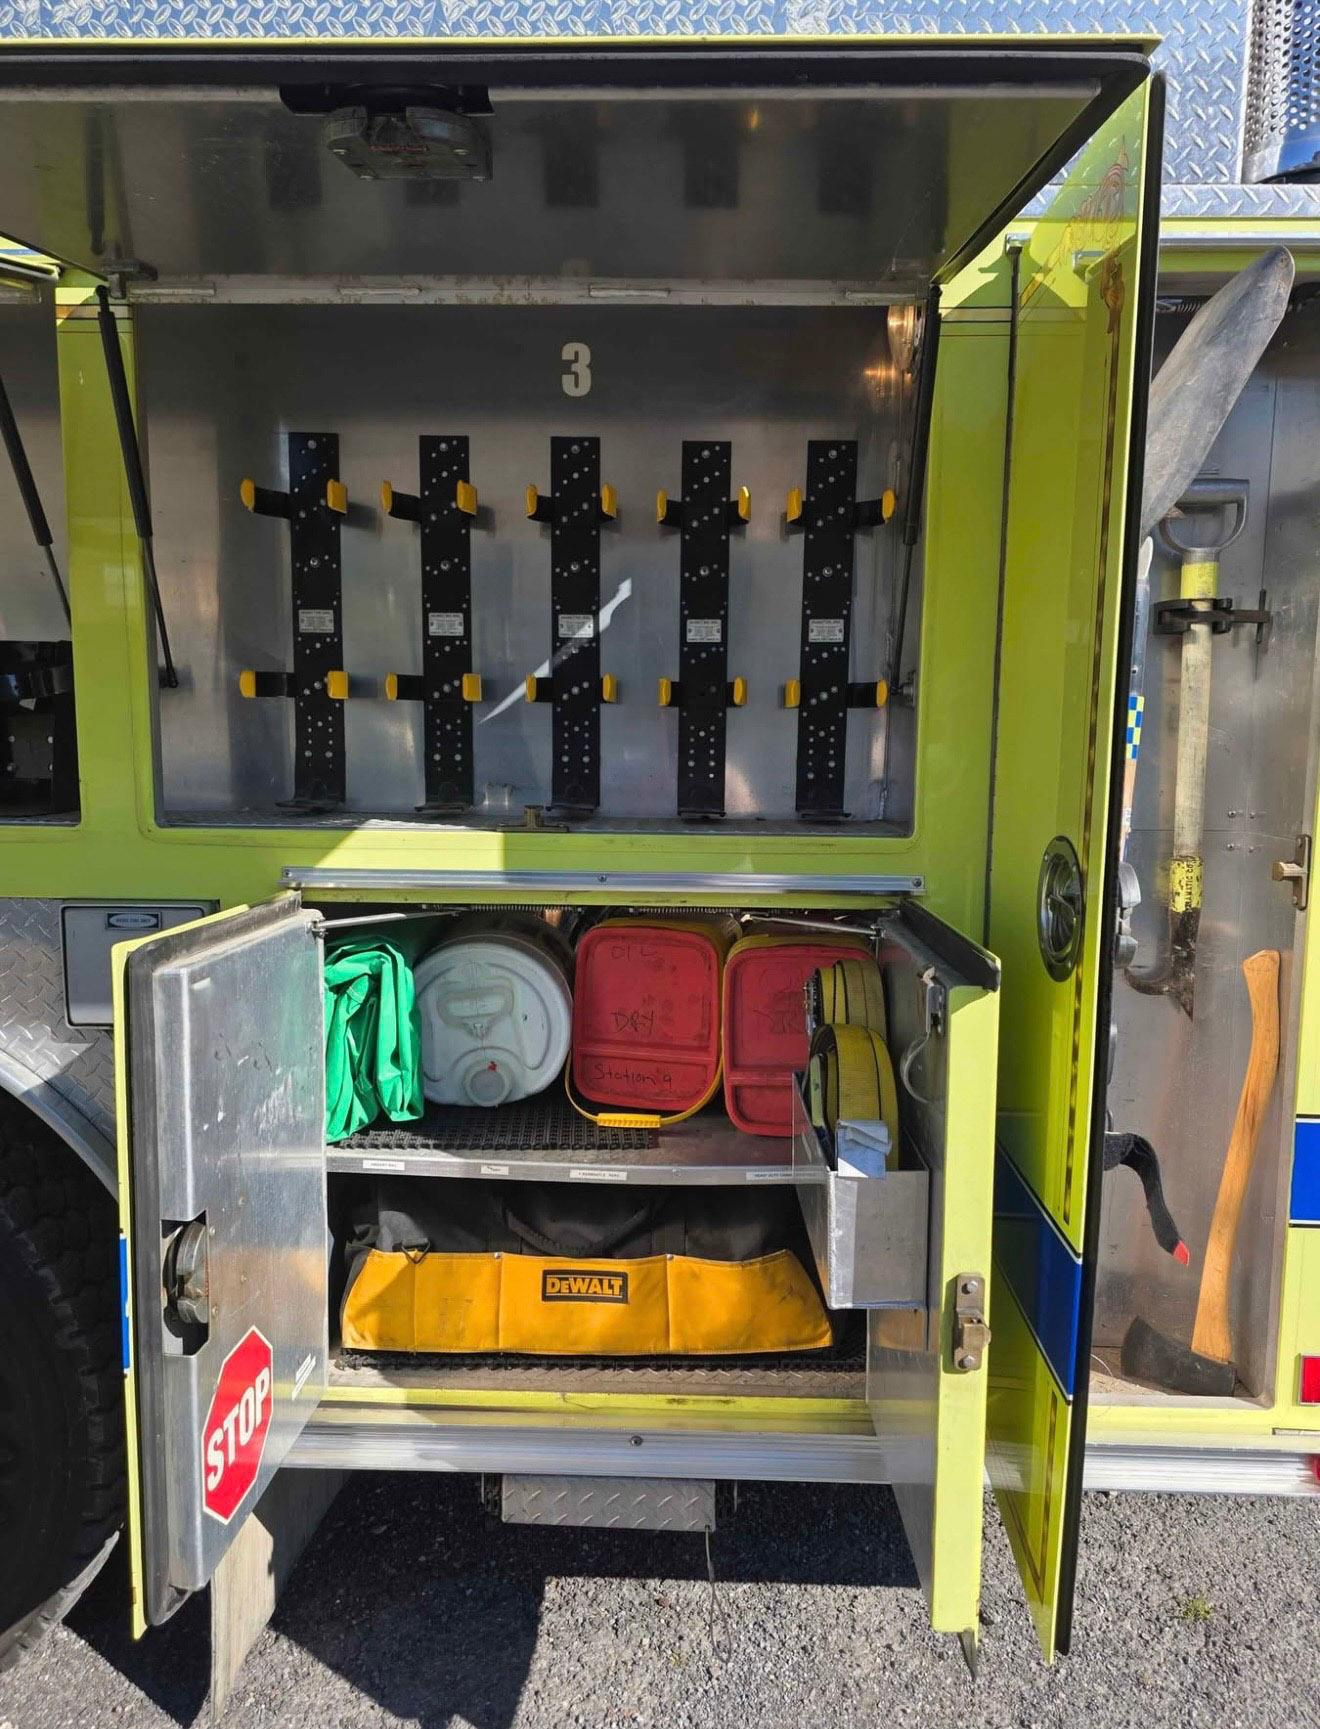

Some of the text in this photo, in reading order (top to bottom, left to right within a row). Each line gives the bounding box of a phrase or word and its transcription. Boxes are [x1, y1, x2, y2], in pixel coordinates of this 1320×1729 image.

[562, 342, 591, 397] 3
[593, 1063, 656, 1085] Station
[207, 1367, 270, 1491] STOP
